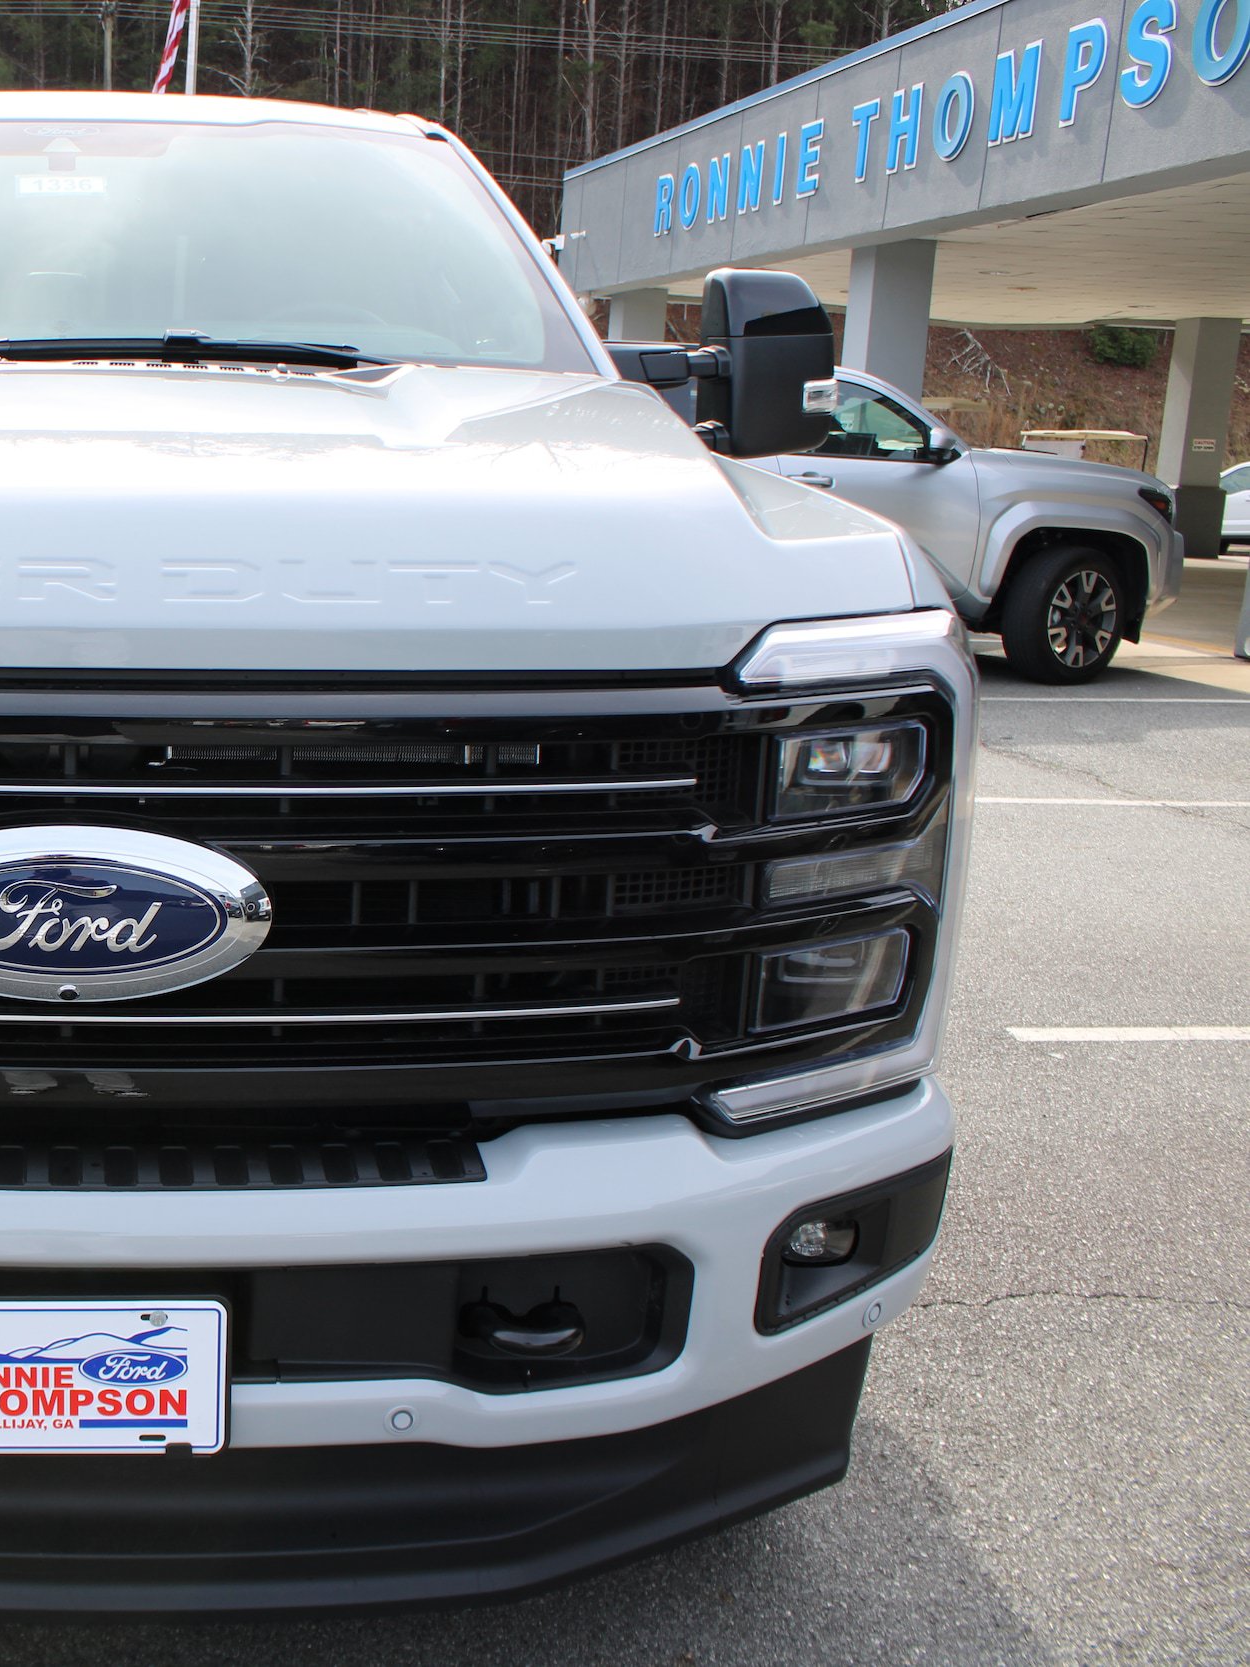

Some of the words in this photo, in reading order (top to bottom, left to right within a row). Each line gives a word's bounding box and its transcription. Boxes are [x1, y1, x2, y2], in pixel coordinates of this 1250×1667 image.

[33, 178, 92, 191] 1336
[653, 118, 824, 238] RONNIE
[160, 558, 580, 606] DUTY
[98, 1353, 167, 1381] Ford
[52, 1420, 74, 1429] GA
